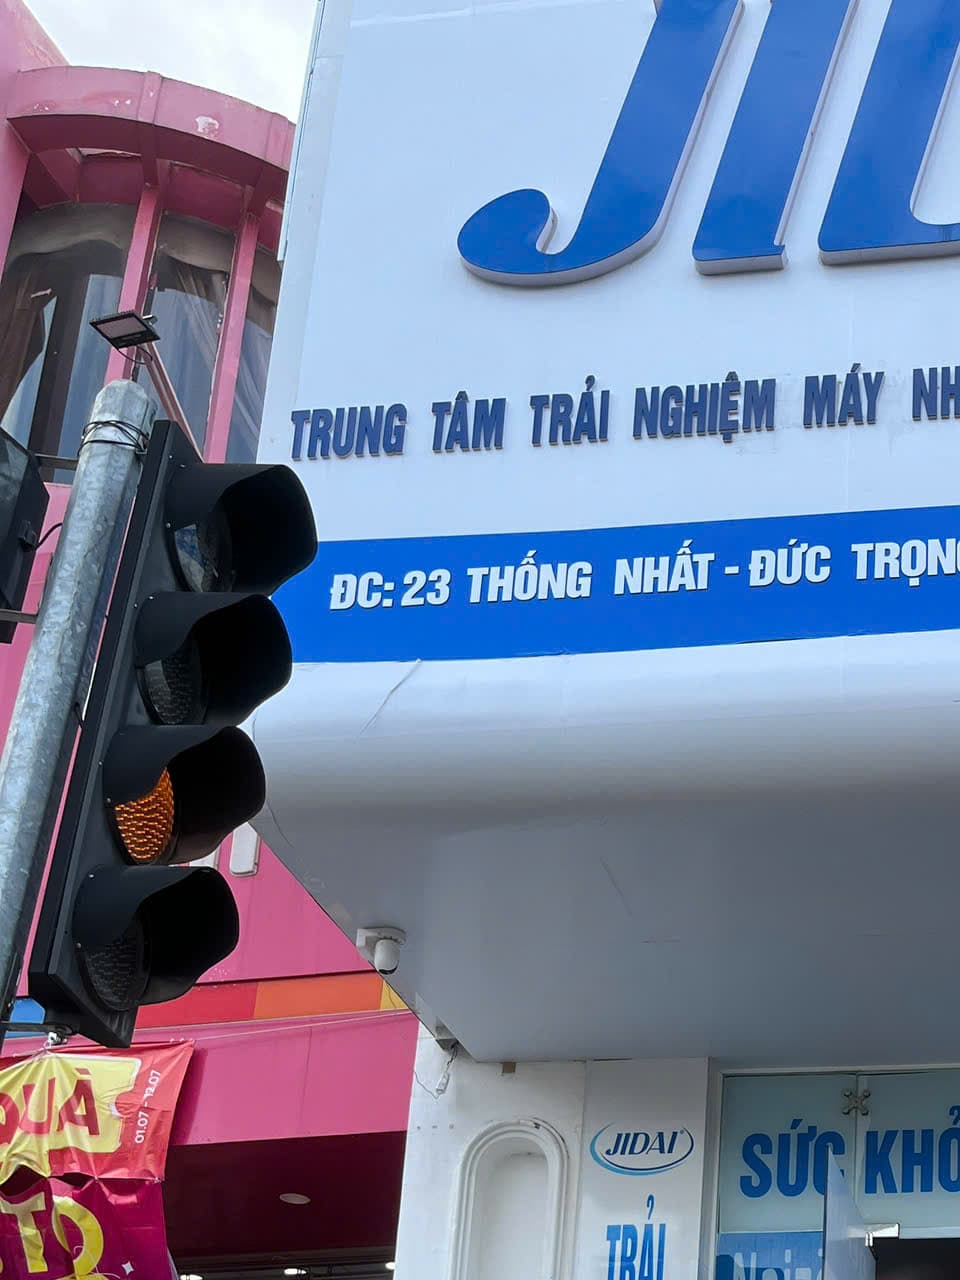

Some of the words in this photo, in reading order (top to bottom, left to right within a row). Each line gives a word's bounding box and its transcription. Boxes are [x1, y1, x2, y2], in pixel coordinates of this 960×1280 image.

[290, 402, 407, 461] TRUNG
[431, 391, 508, 455] TÂM
[530, 375, 612, 447] TRẢI
[632, 371, 777, 444] NGHIỆM
[803, 362, 885, 430] MÁY
[330, 573, 394, 611] ĐC:
[402, 569, 451, 607] 23
[467, 550, 593, 604] THỐNG
[613, 539, 718, 595] NHẤT
[748, 541, 832, 587] ĐỨC
[134, 1110, 150, 1144] 01.07
[143, 1069, 161, 1101] 12.07
[604, 1132, 680, 1157] JIDAI
[740, 1117, 846, 1198] SỨC
